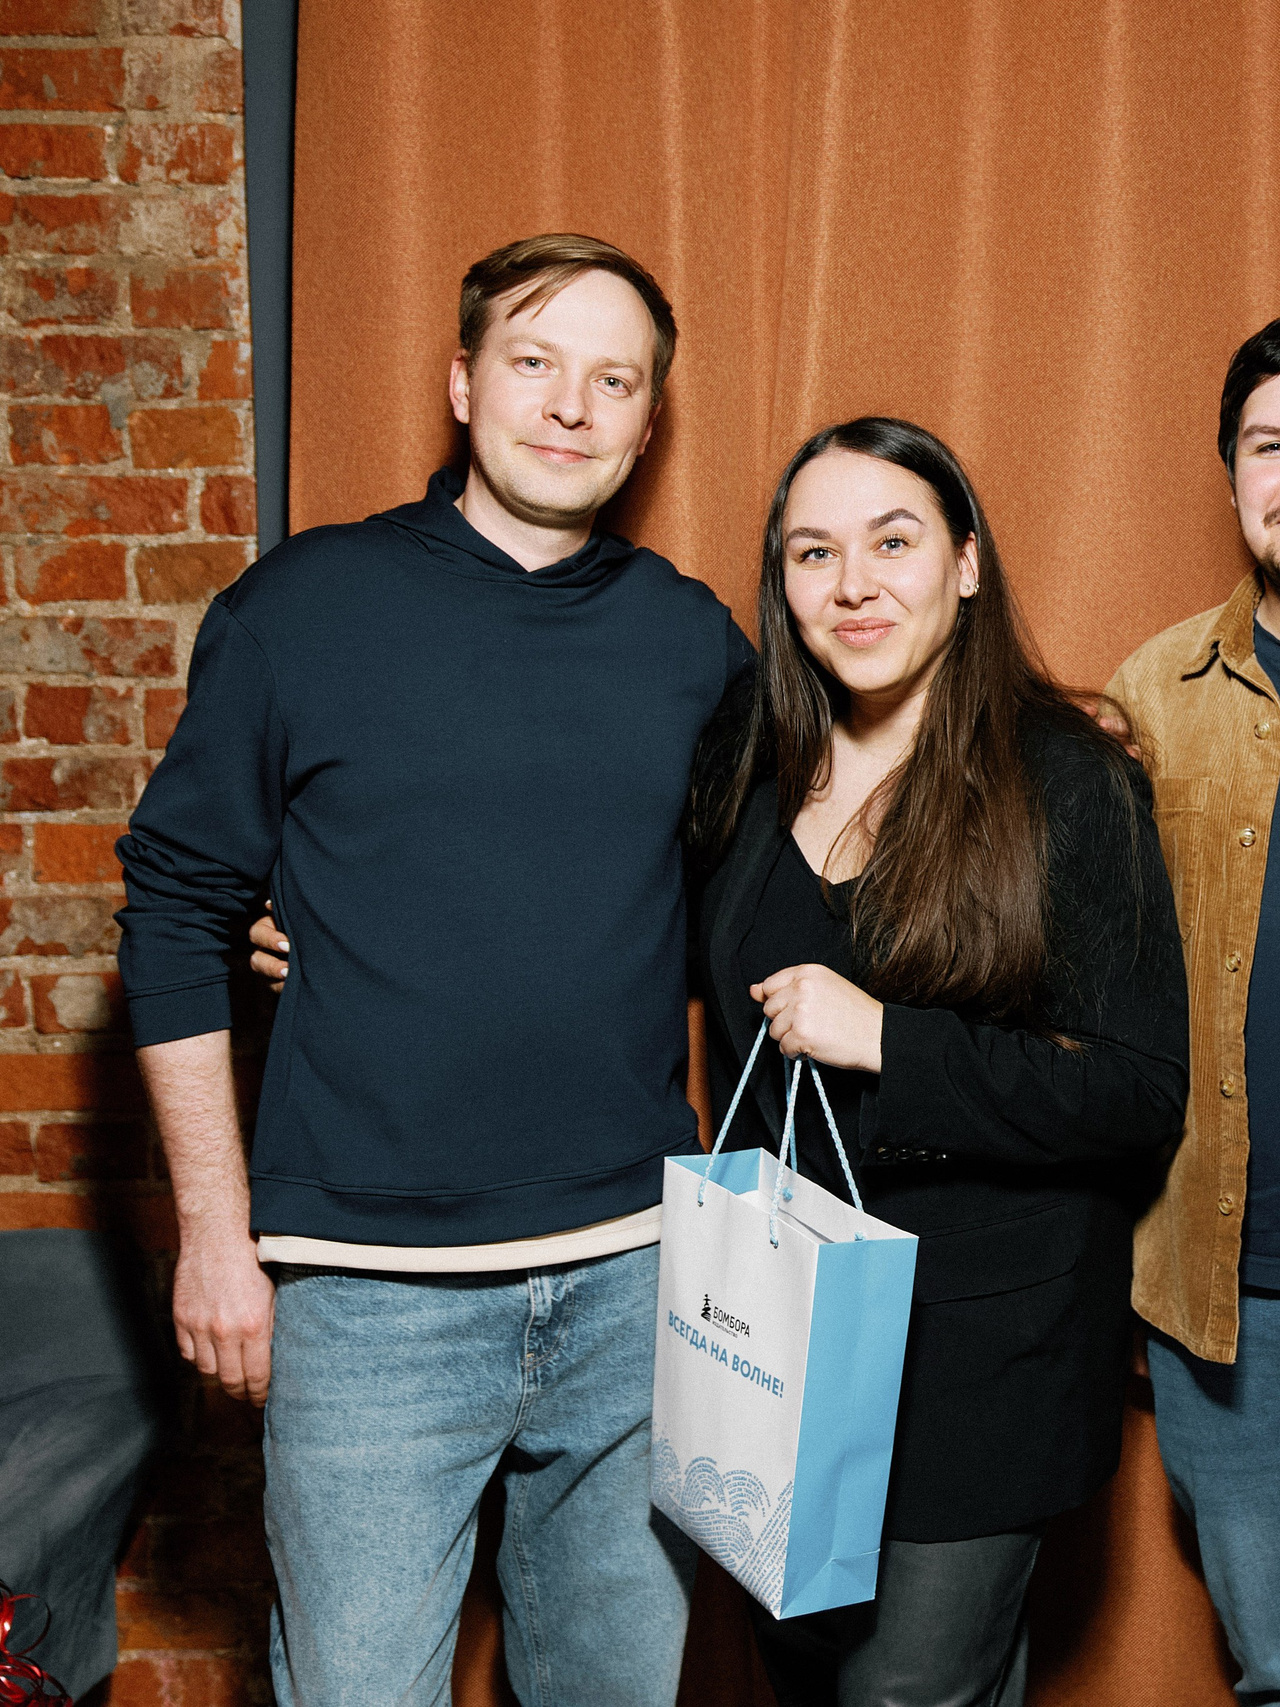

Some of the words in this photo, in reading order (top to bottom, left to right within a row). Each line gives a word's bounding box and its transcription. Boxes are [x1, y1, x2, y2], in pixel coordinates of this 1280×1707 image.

[713, 1306, 750, 1338] БОМБОРА
[668, 1309, 707, 1353] ВСЕГДА
[710, 1341, 728, 1367] НА
[731, 1354, 784, 1399] ВОЛНЕ!
